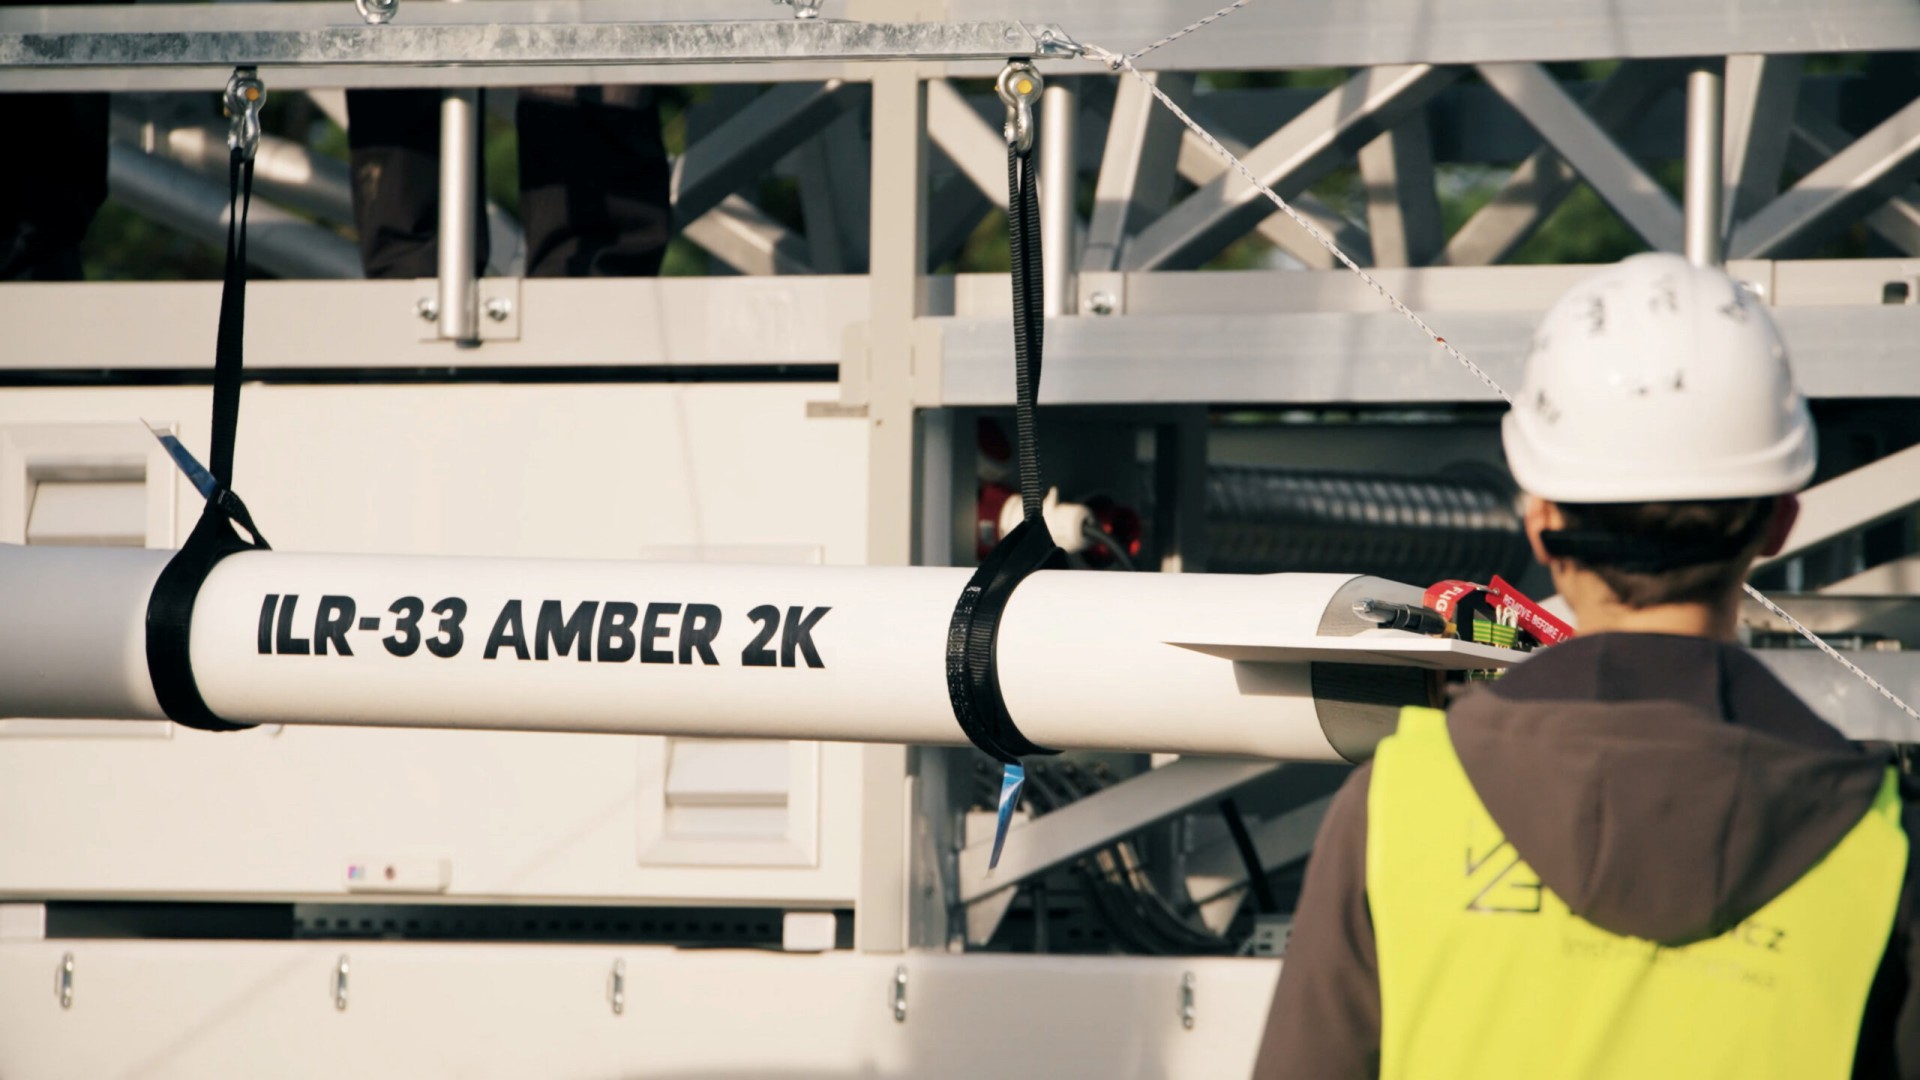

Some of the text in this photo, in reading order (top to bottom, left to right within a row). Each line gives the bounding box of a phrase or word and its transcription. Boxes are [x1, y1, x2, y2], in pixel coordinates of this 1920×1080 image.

[1435, 586, 1464, 612] FLIG
[1503, 594, 1532, 622] REMOVE
[1531, 614, 1559, 640] BEFORE
[257, 594, 832, 669] ILR-33 AMBER 2K
